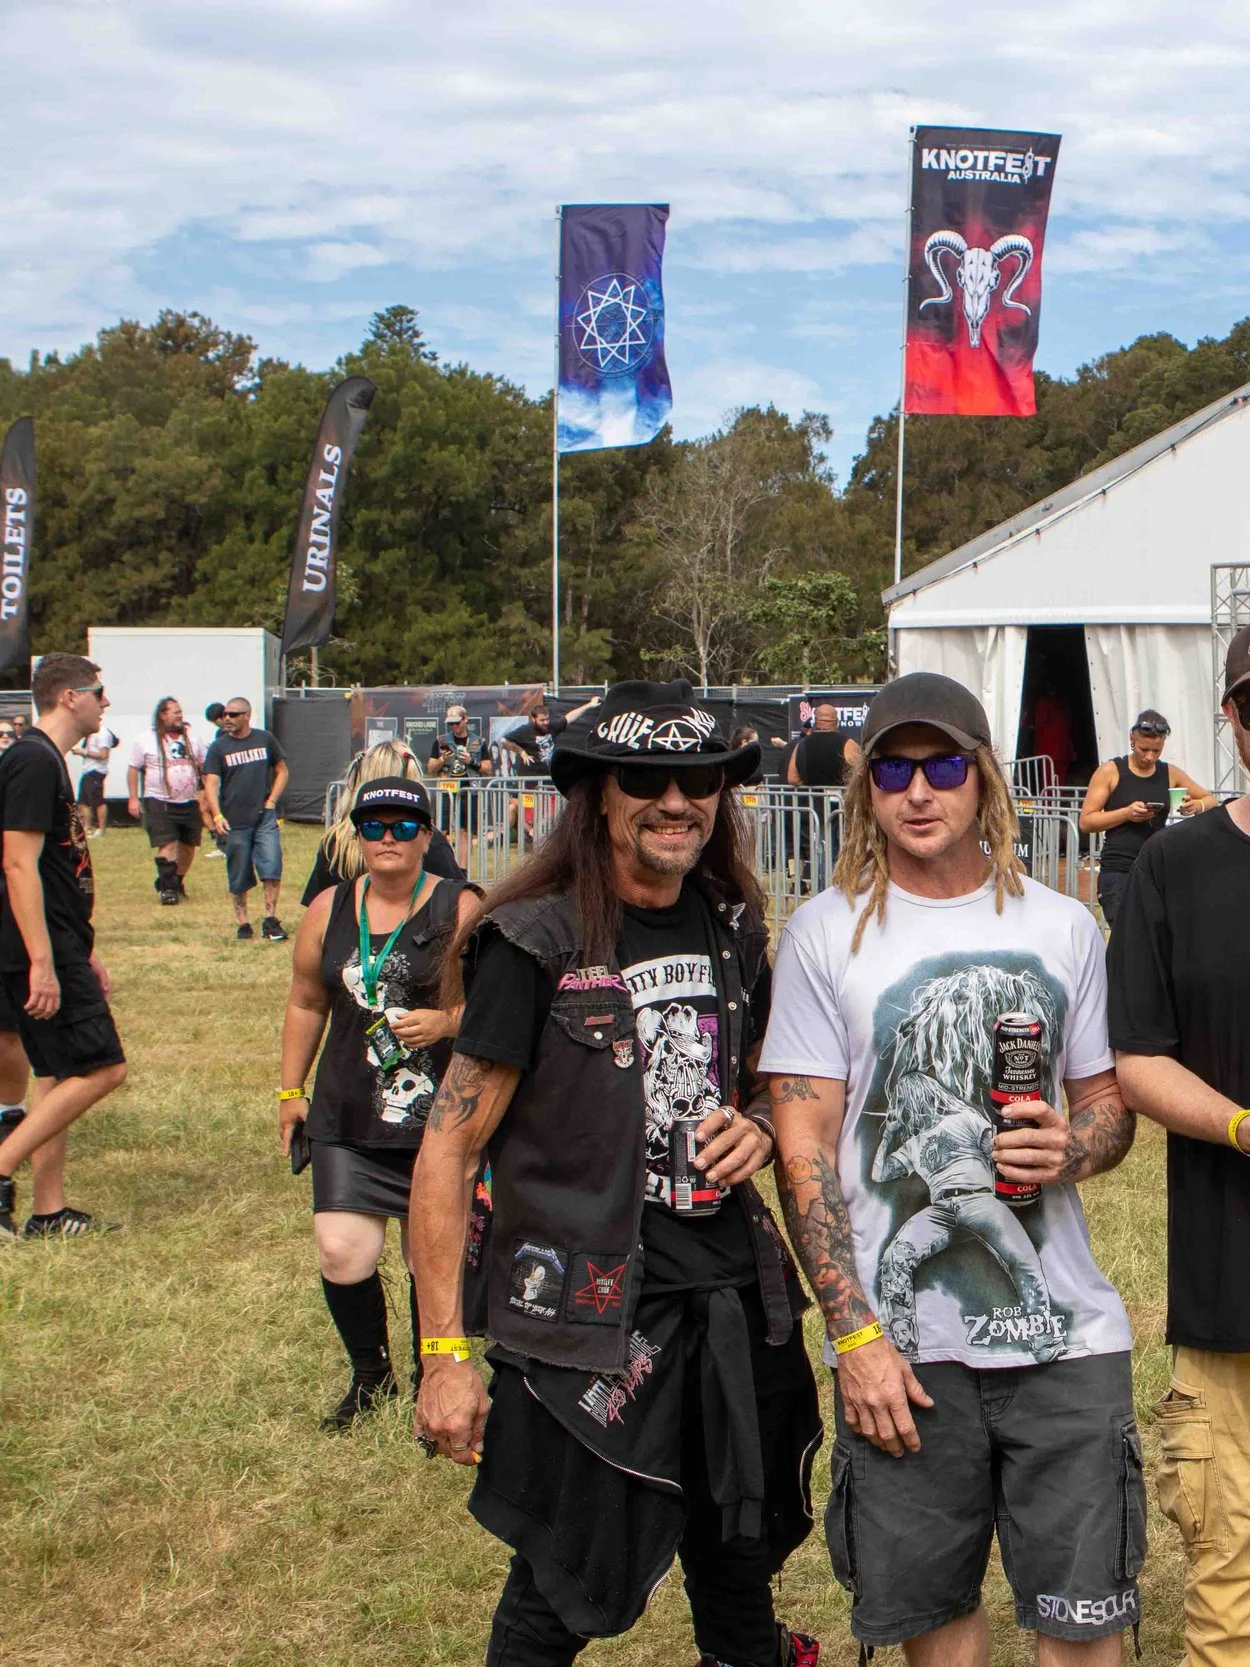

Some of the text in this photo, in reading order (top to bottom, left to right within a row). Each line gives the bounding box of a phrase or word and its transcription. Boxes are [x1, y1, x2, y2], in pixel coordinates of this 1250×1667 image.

[922, 147, 1051, 180] KNOTFEST
[947, 170, 1021, 183] AUSTRALIA
[302, 443, 342, 593] URINALS
[1, 487, 28, 620] TOILETS
[363, 789, 420, 802] KNOTFEST
[663, 962, 698, 985] BOY
[999, 1041, 1016, 1053] JACK
[1005, 1067, 1035, 1075] Tennessee
[1017, 1183, 1037, 1192] COLA
[992, 1307, 1021, 1319] ROB
[964, 1305, 1067, 1345] ZOMBIE
[427, 1341, 439, 1351] 18+
[578, 1374, 621, 1428] MÖTLE
